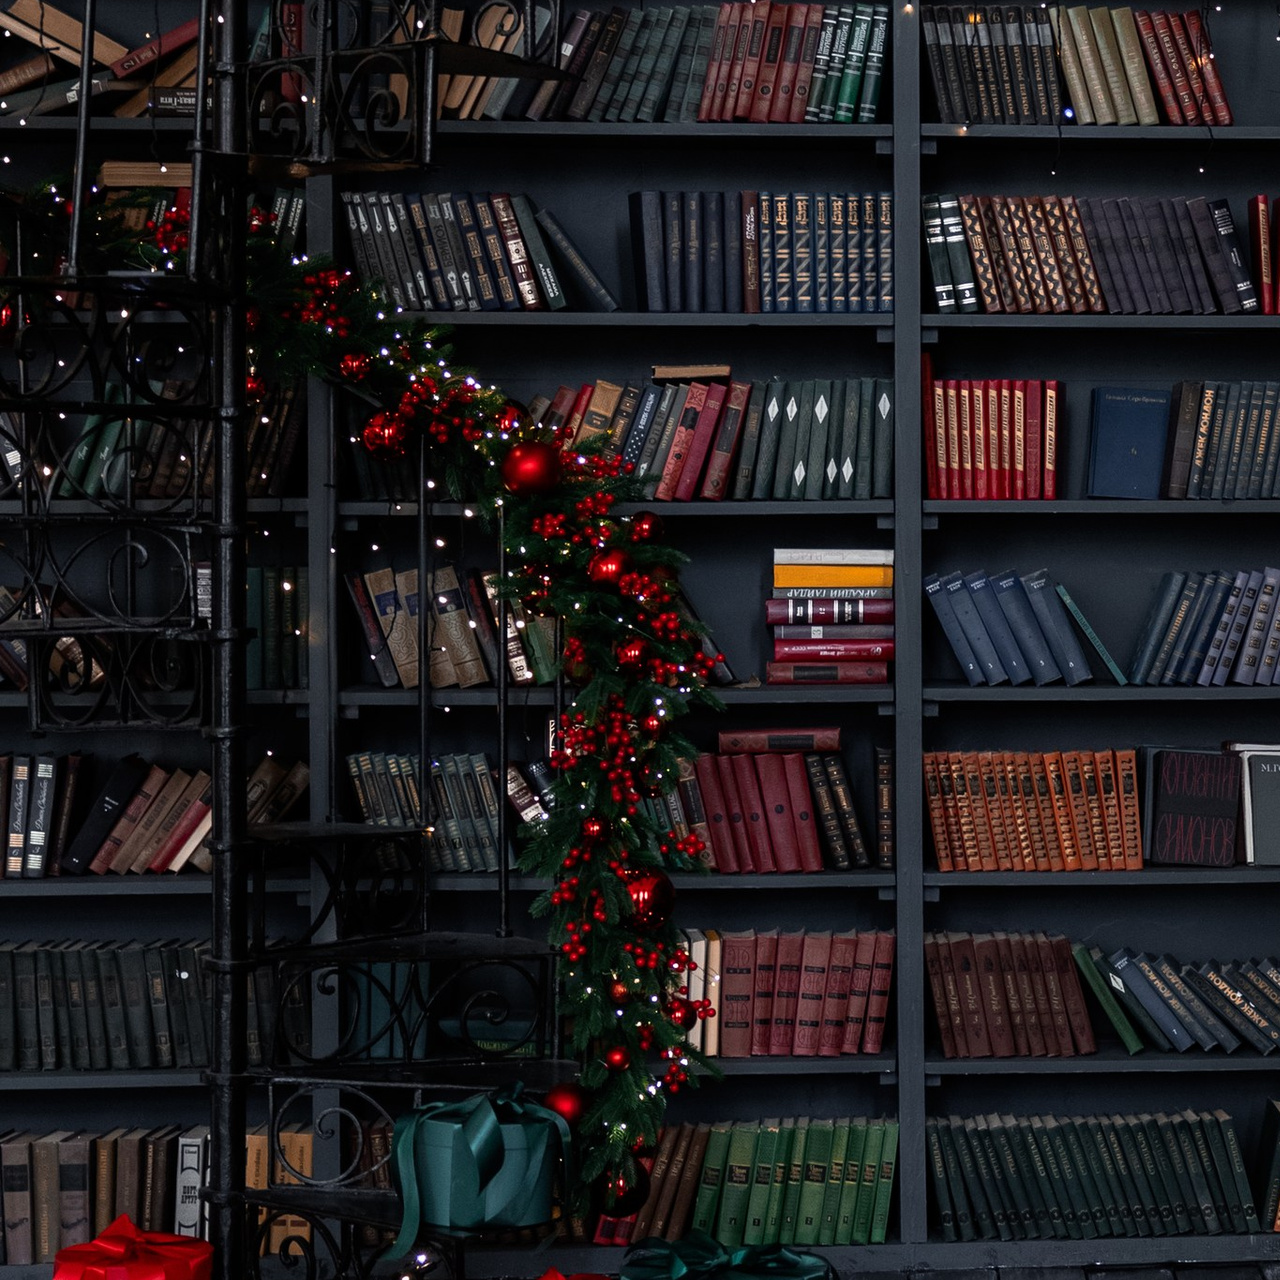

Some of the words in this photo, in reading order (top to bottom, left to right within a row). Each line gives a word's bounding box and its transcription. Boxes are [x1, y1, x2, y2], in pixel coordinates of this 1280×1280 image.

[854, 21, 868, 51] ШУНДИК
[874, 22, 888, 51] ШУНДИК
[984, 46, 995, 81] РОЛЛАН
[997, 46, 1010, 81] РОЛЛАН
[1012, 46, 1024, 81] РОЛЛАН
[1030, 46, 1043, 81] РОЛЛАН
[992, 82, 1003, 117] РОМЕН
[1005, 82, 1016, 116] РОМЕН
[1019, 82, 1031, 116] РОМЕН
[1037, 82, 1049, 116] РОМЕН
[1200, 389, 1215, 434] ЛОНДОН
[1194, 436, 1207, 468] ДЖЕК
[787, 589, 827, 598] ГАЙДАР
[830, 589, 877, 598] АРКАДИЙ
